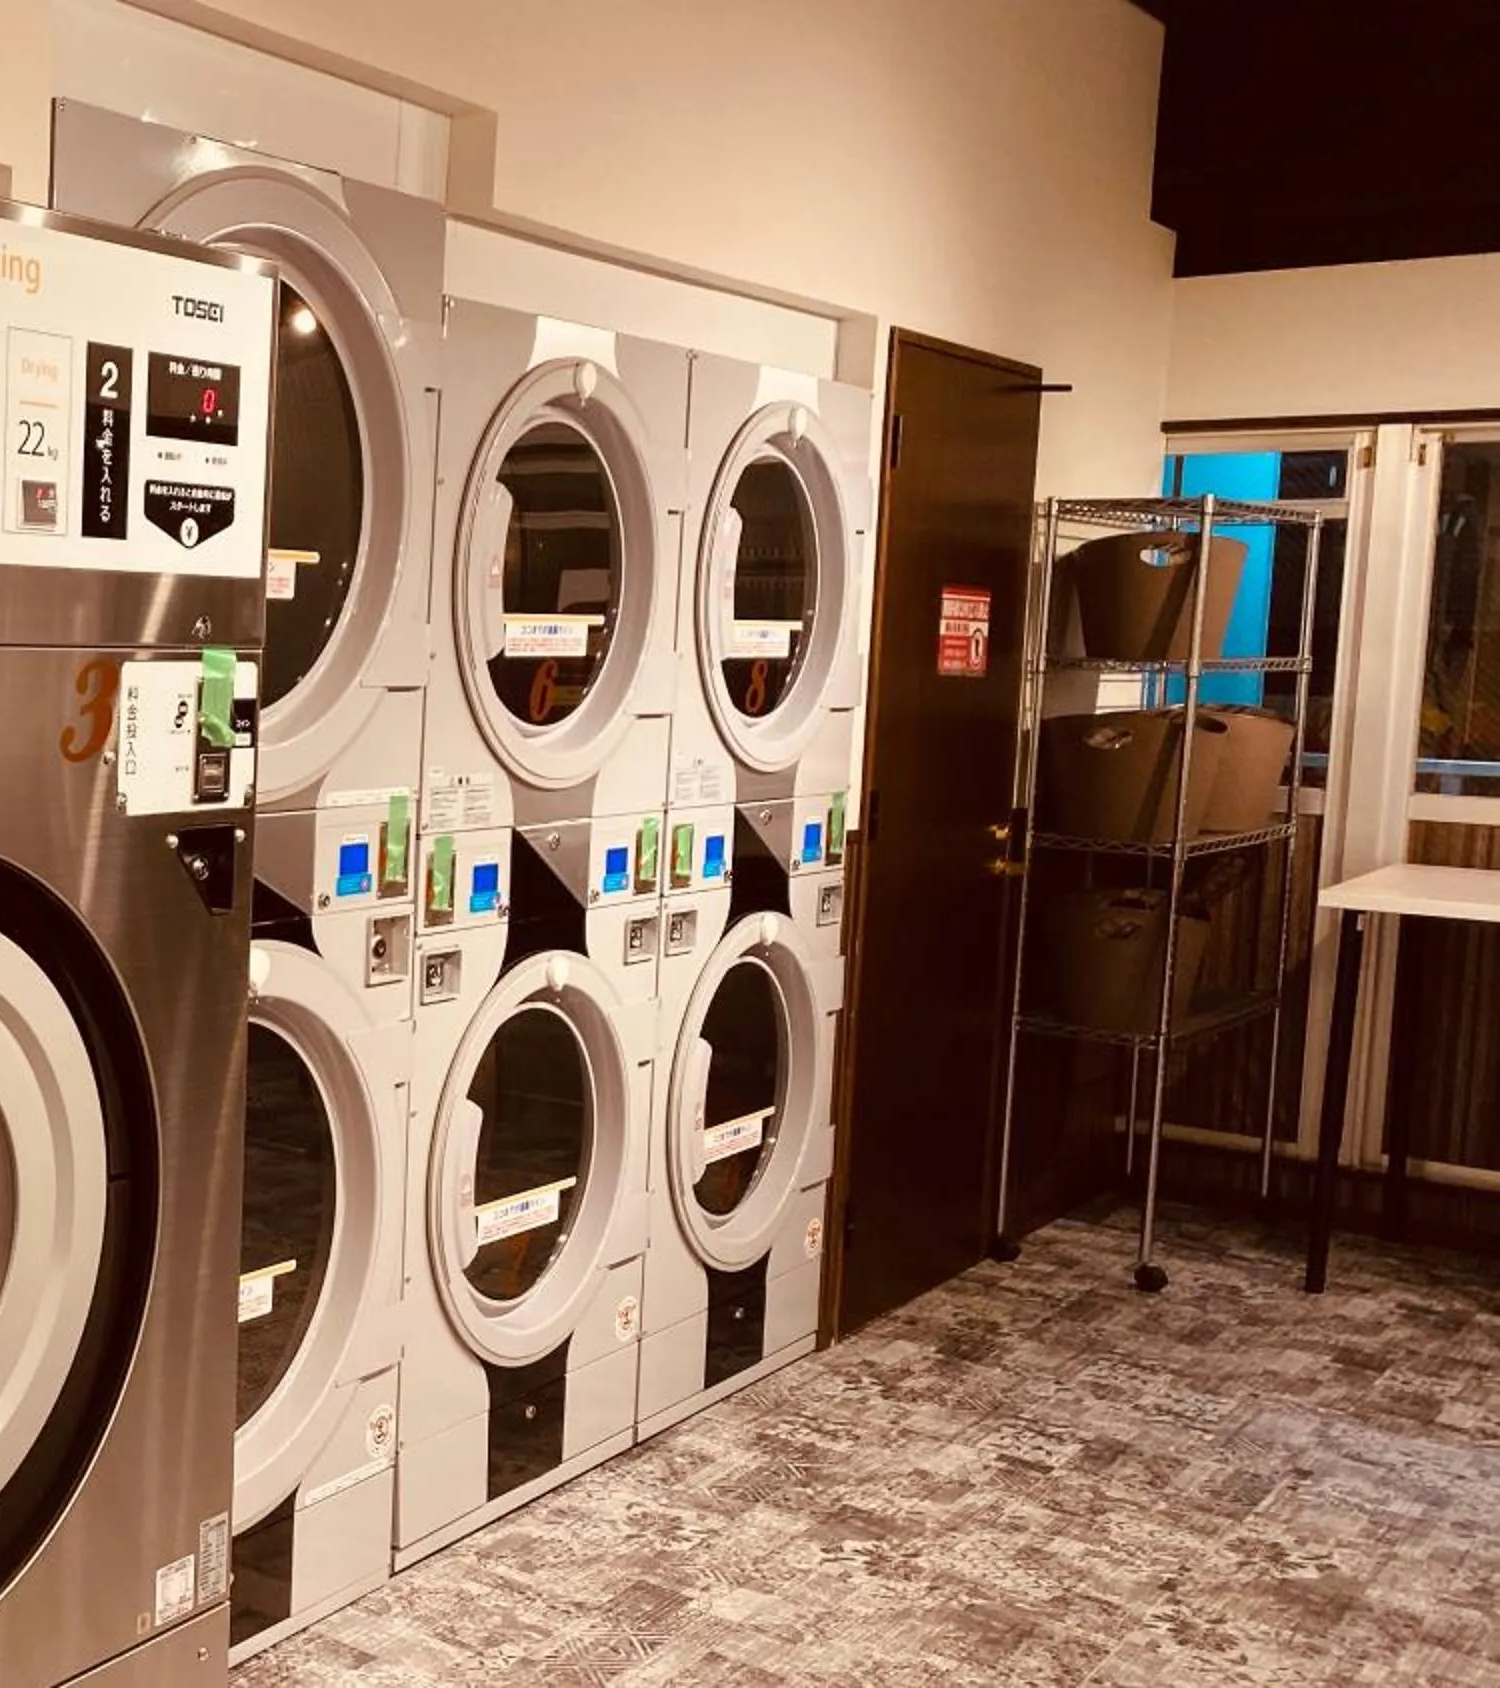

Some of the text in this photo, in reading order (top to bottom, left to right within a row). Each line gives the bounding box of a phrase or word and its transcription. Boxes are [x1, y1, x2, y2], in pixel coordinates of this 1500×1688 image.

[172, 295, 224, 323] TOSEI
[21, 358, 58, 382] Drying
[203, 389, 215, 413] 0
[59, 658, 120, 763] 3
